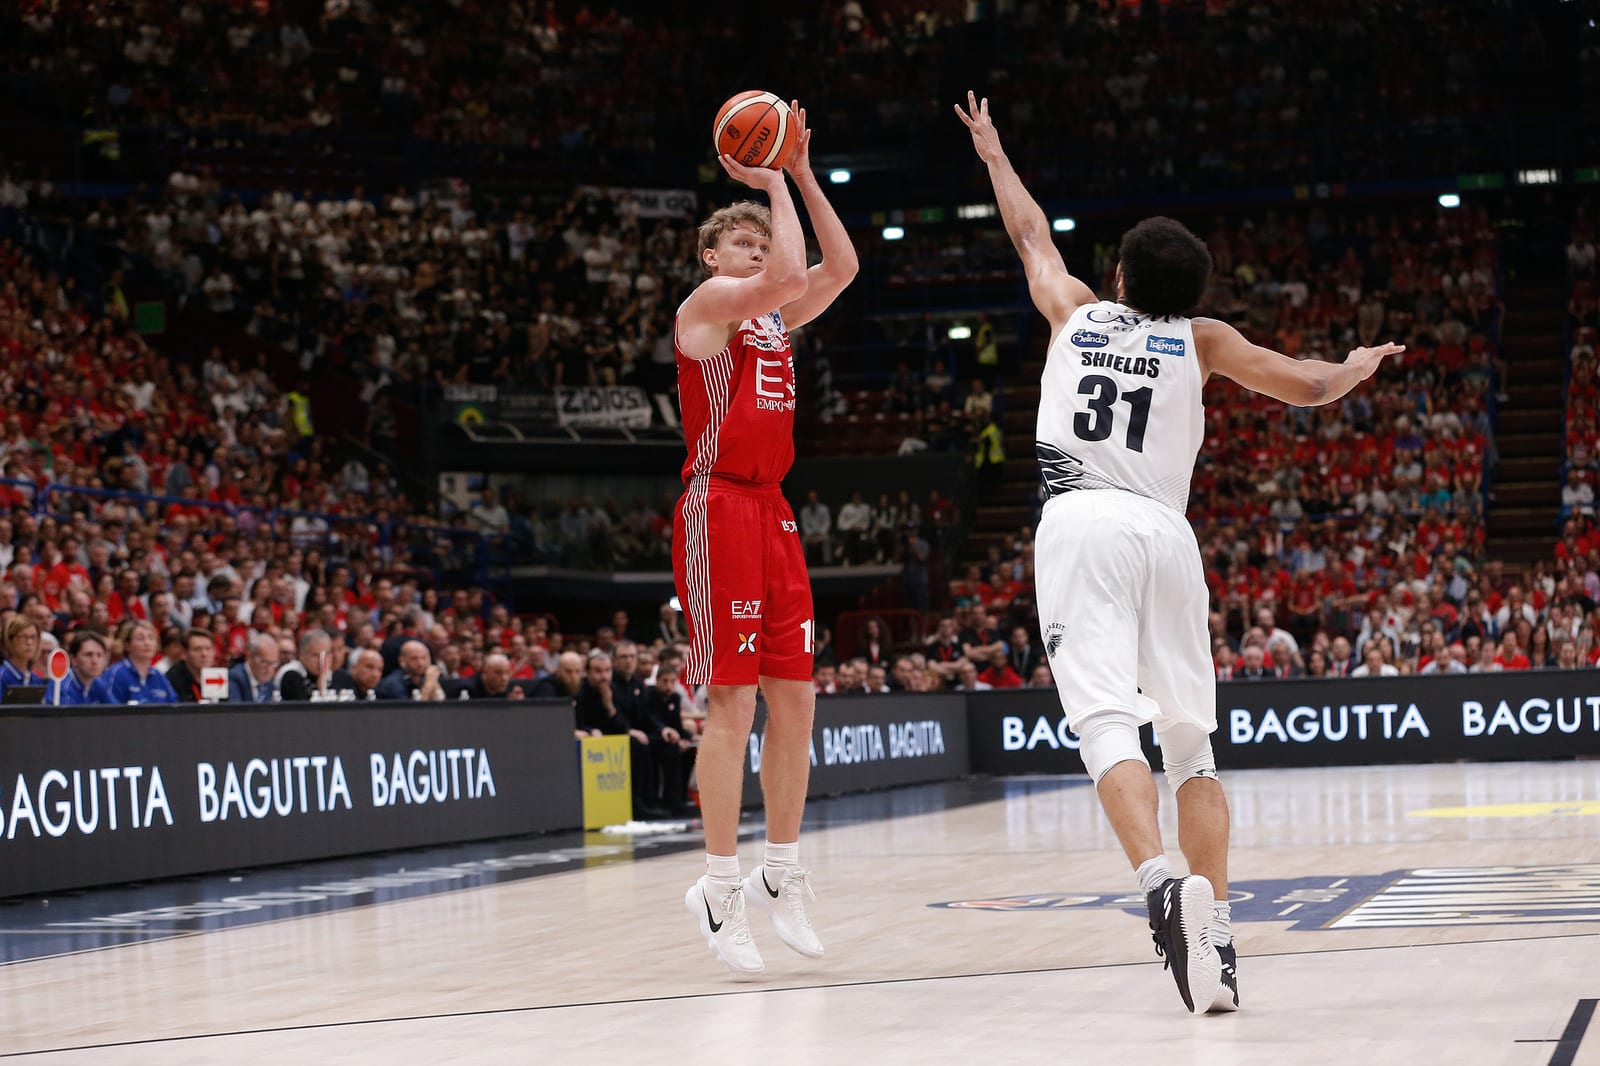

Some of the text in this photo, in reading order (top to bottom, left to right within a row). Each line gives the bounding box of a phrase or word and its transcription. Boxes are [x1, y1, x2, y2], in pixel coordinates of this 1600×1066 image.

[1081, 352, 1160, 378] SHIELDS
[1073, 375, 1153, 453] 31
[731, 600, 761, 615] EA7
[800, 619, 815, 655] 1
[822, 724, 885, 766] BAGUTTA
[888, 720, 945, 759] BAGUTTA
[1231, 703, 1430, 744] BAGUTTA
[1463, 696, 1600, 736] BAGUT
[0, 748, 496, 840] AGUTTA BAGUTTA BAGUTTA
